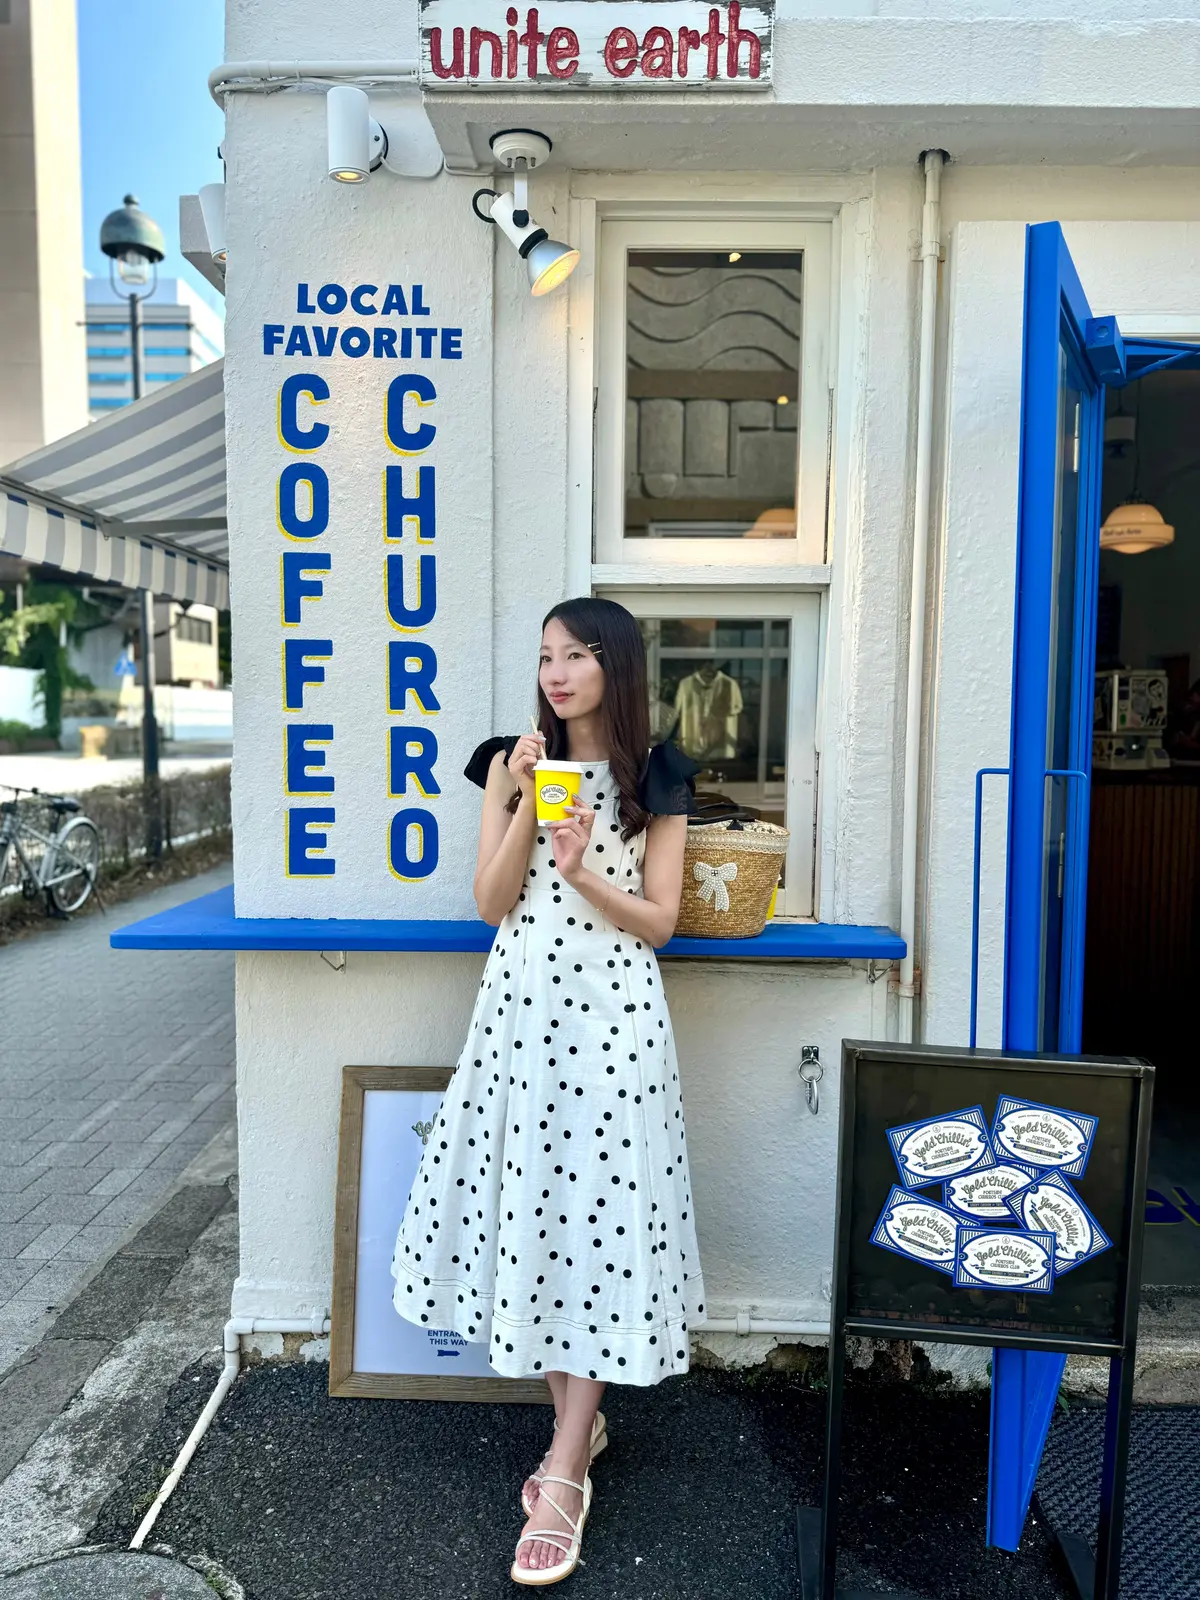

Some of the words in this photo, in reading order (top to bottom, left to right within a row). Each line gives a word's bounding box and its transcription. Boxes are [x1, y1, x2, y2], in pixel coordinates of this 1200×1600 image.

[430, 7, 580, 79] unite
[605, 1, 762, 79] earth
[297, 283, 430, 315] LOCAL
[263, 324, 463, 359] FAVORITE
[276, 374, 336, 878] COFFEE
[383, 374, 441, 882] CHURRO
[427, 1330, 464, 1338] ENTRAN
